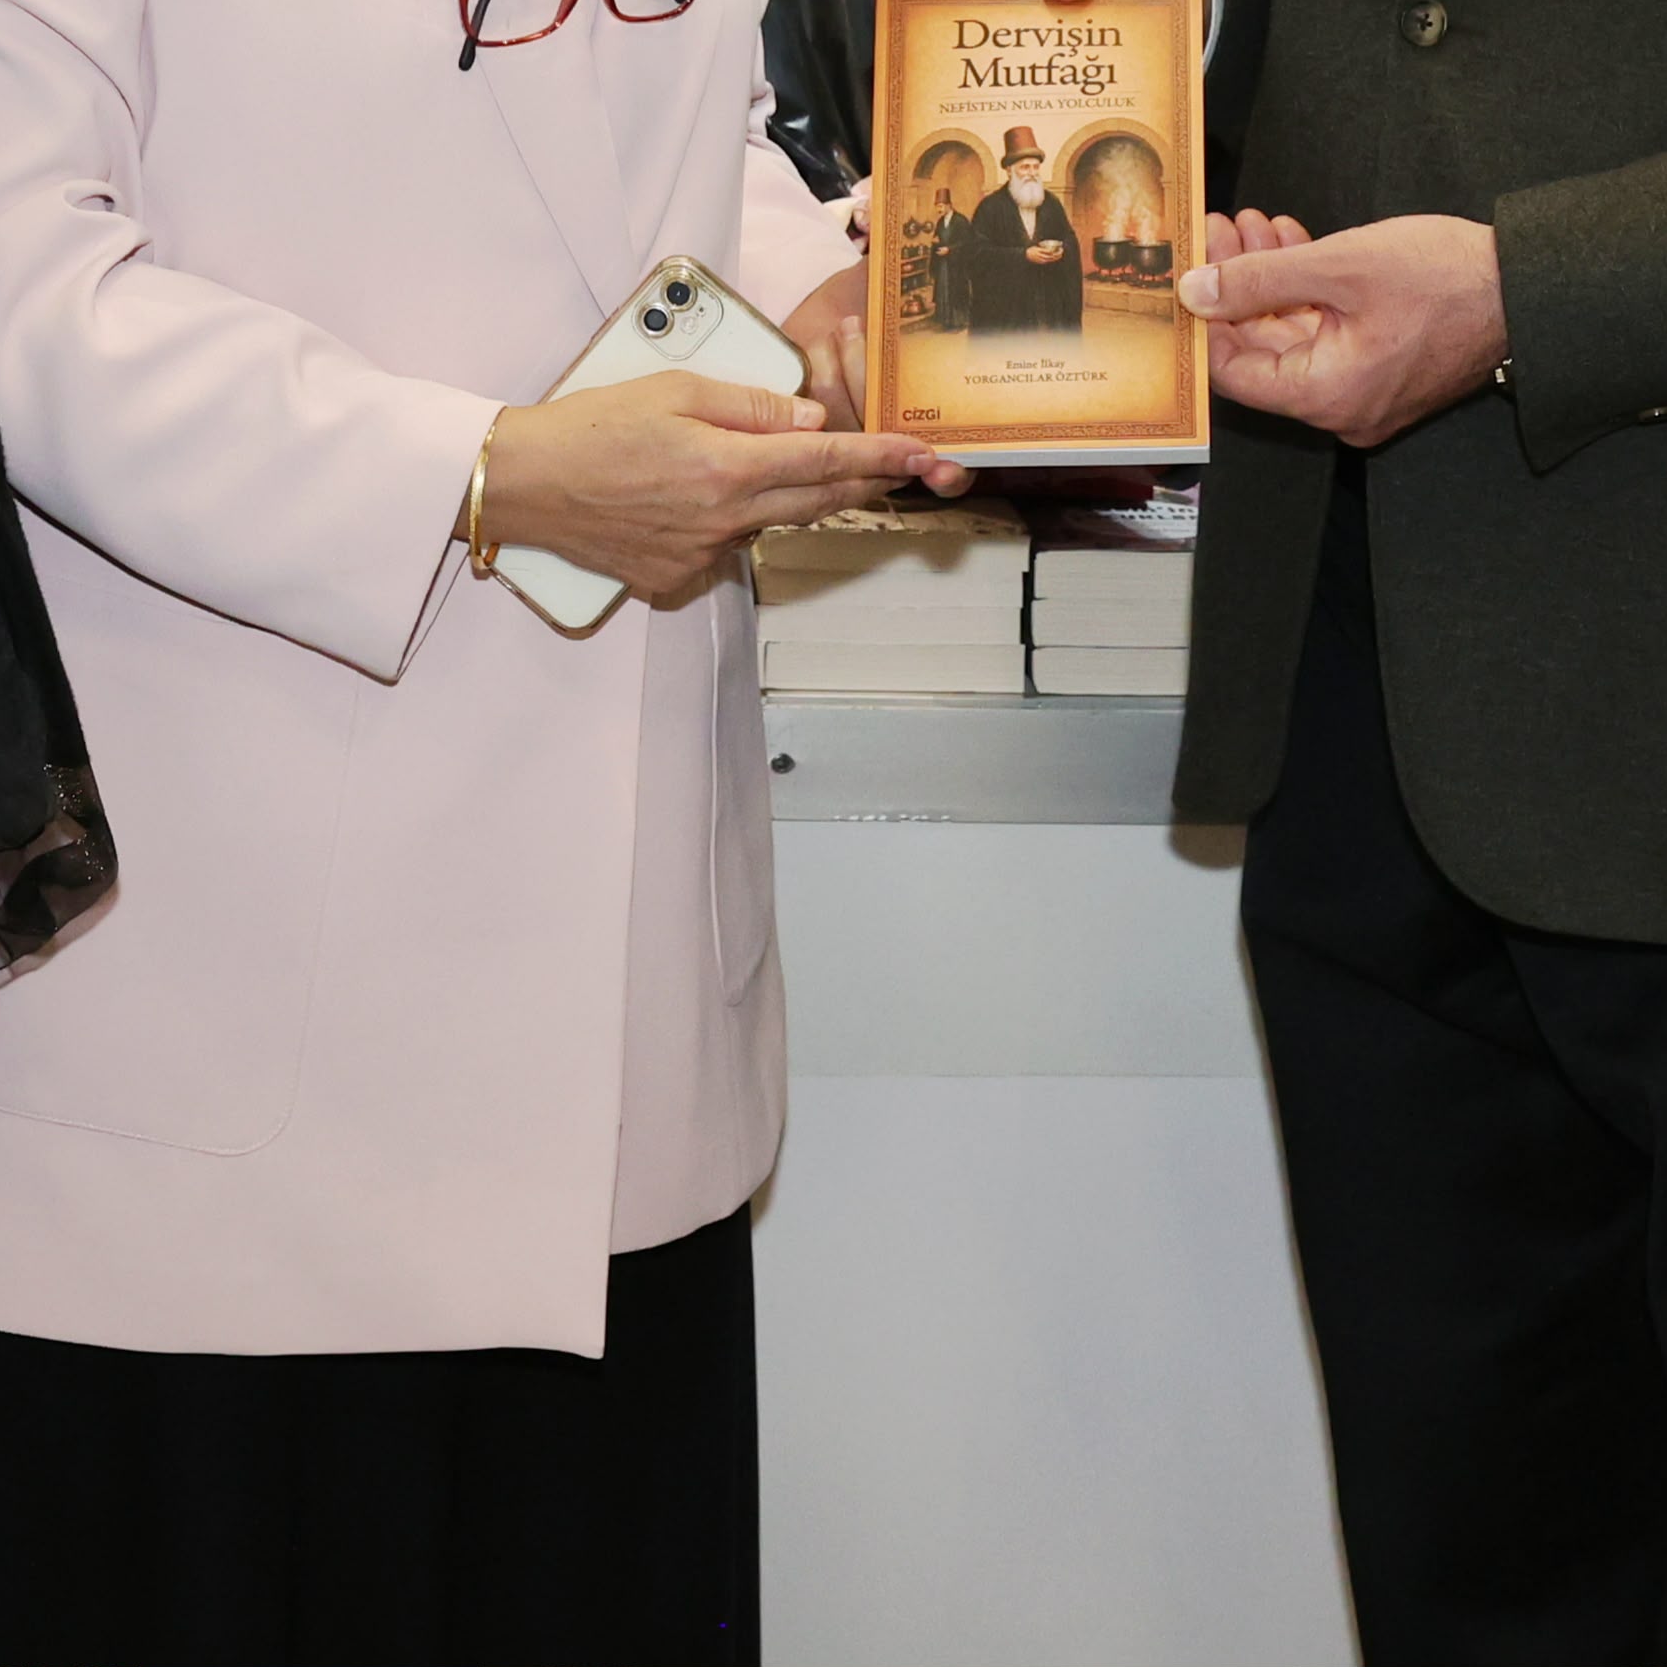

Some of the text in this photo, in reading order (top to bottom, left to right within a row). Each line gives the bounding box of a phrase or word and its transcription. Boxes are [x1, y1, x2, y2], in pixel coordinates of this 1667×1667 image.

[951, 18, 1123, 58] Dervişin
[957, 52, 1118, 96] Mutfağı
[939, 96, 1137, 114] NEFİSTEN NURA YOLCULUK
[1005, 360, 1039, 370] Emine
[963, 370, 1109, 385] YORGANCILAR ÖZTÜRK
